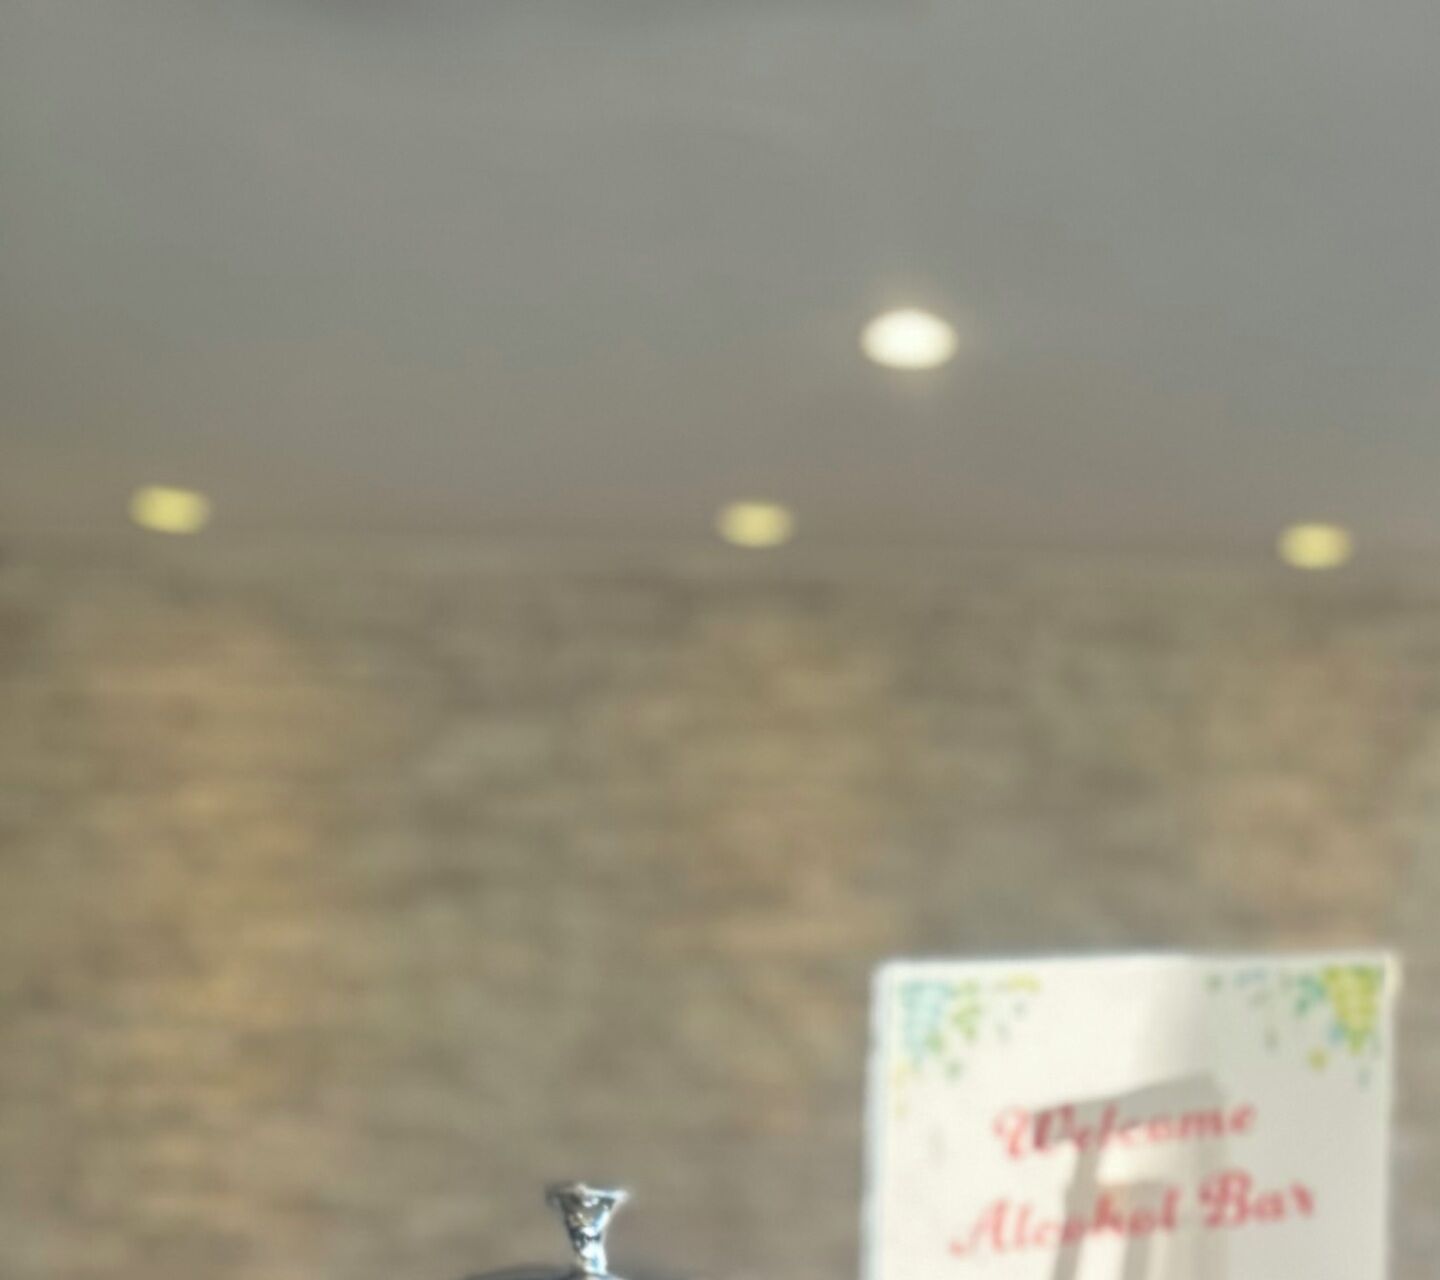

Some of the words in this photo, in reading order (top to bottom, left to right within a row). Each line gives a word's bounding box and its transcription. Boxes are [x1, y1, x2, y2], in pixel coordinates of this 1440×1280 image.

[992, 1103, 1256, 1158] Welcome
[950, 1184, 1181, 1256] Alcohol
[1197, 1169, 1314, 1228] Bar
